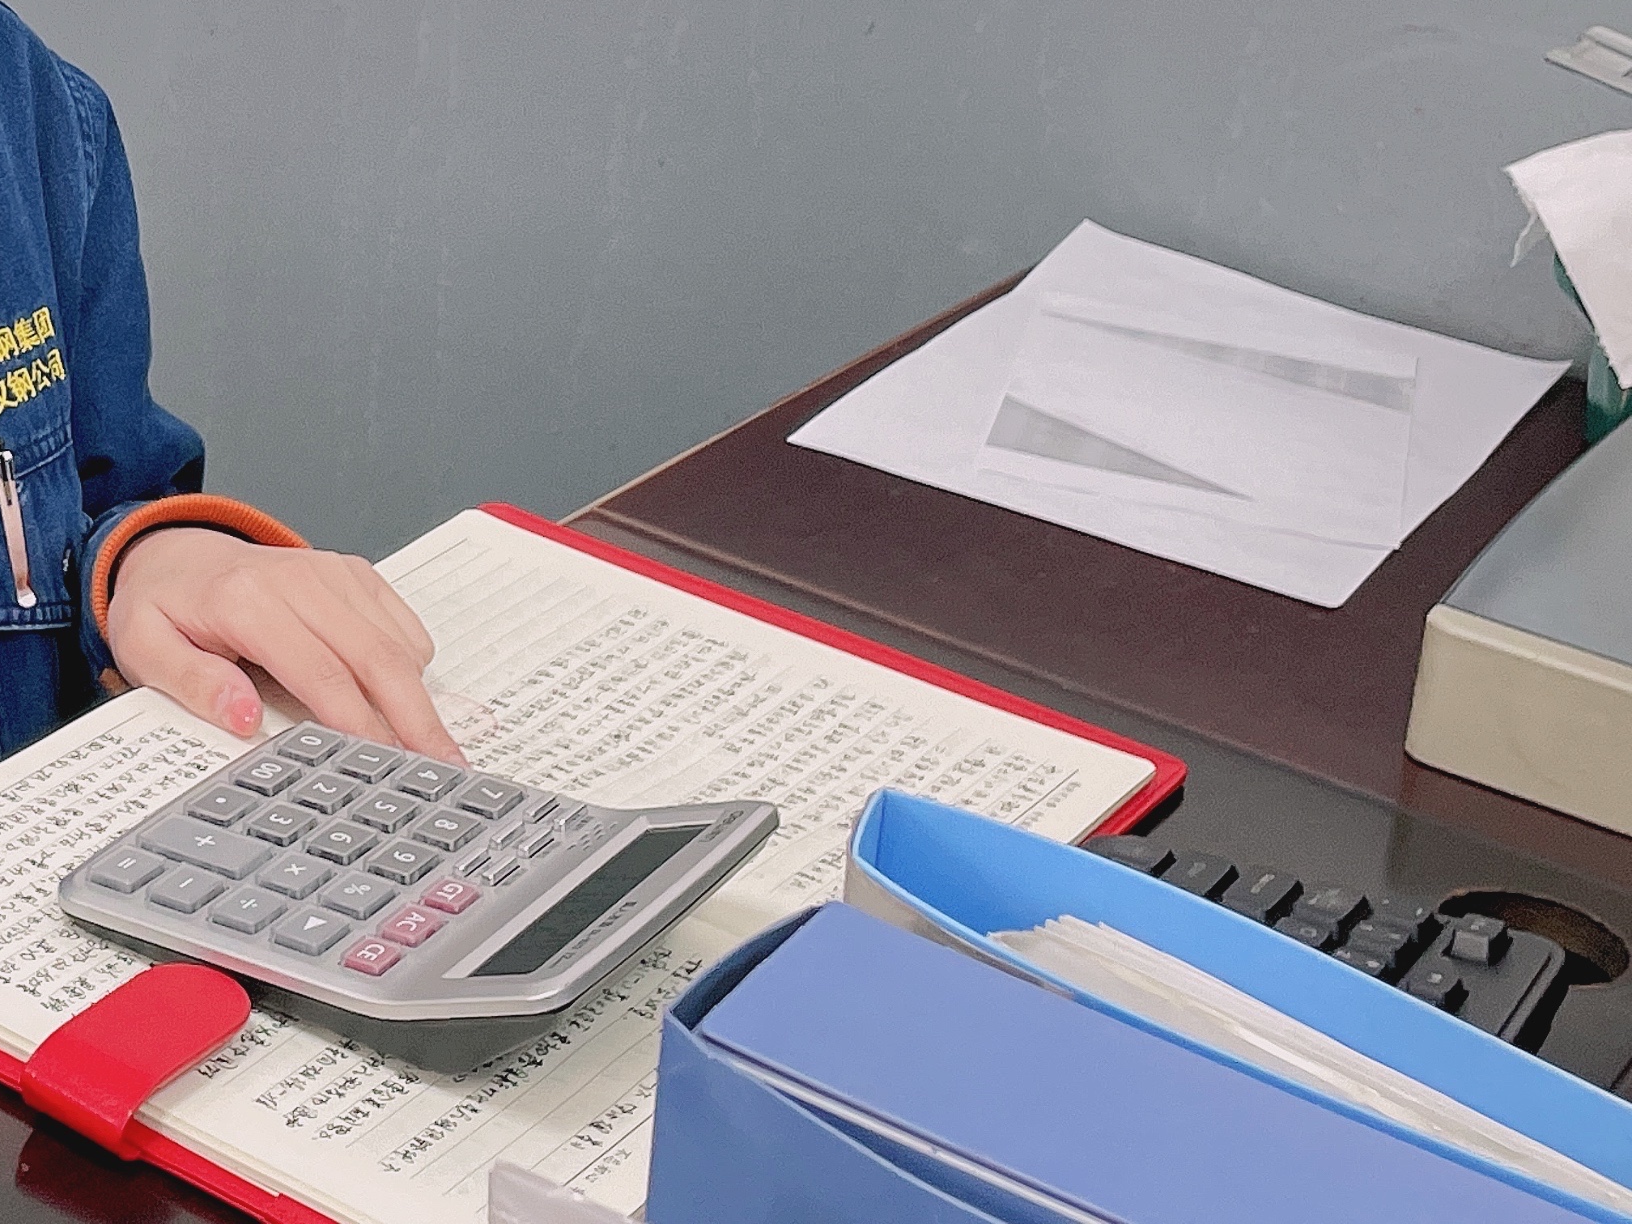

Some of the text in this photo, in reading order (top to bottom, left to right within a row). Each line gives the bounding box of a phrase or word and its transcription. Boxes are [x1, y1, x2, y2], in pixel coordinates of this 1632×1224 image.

[300, 735, 322, 747] 0
[358, 753, 380, 763] 1
[251, 762, 282, 779] 00
[417, 769, 439, 782] 4
[317, 782, 337, 794] 2
[481, 786, 503, 800] 7
[375, 800, 397, 814] 5
[270, 813, 294, 826] 3
[434, 818, 458, 832] 8
[329, 831, 352, 844] 6
[393, 850, 416, 863] 9
[344, 882, 371, 896] %
[436, 883, 464, 902] GT
[395, 911, 426, 931] AC
[357, 943, 386, 960] CE
